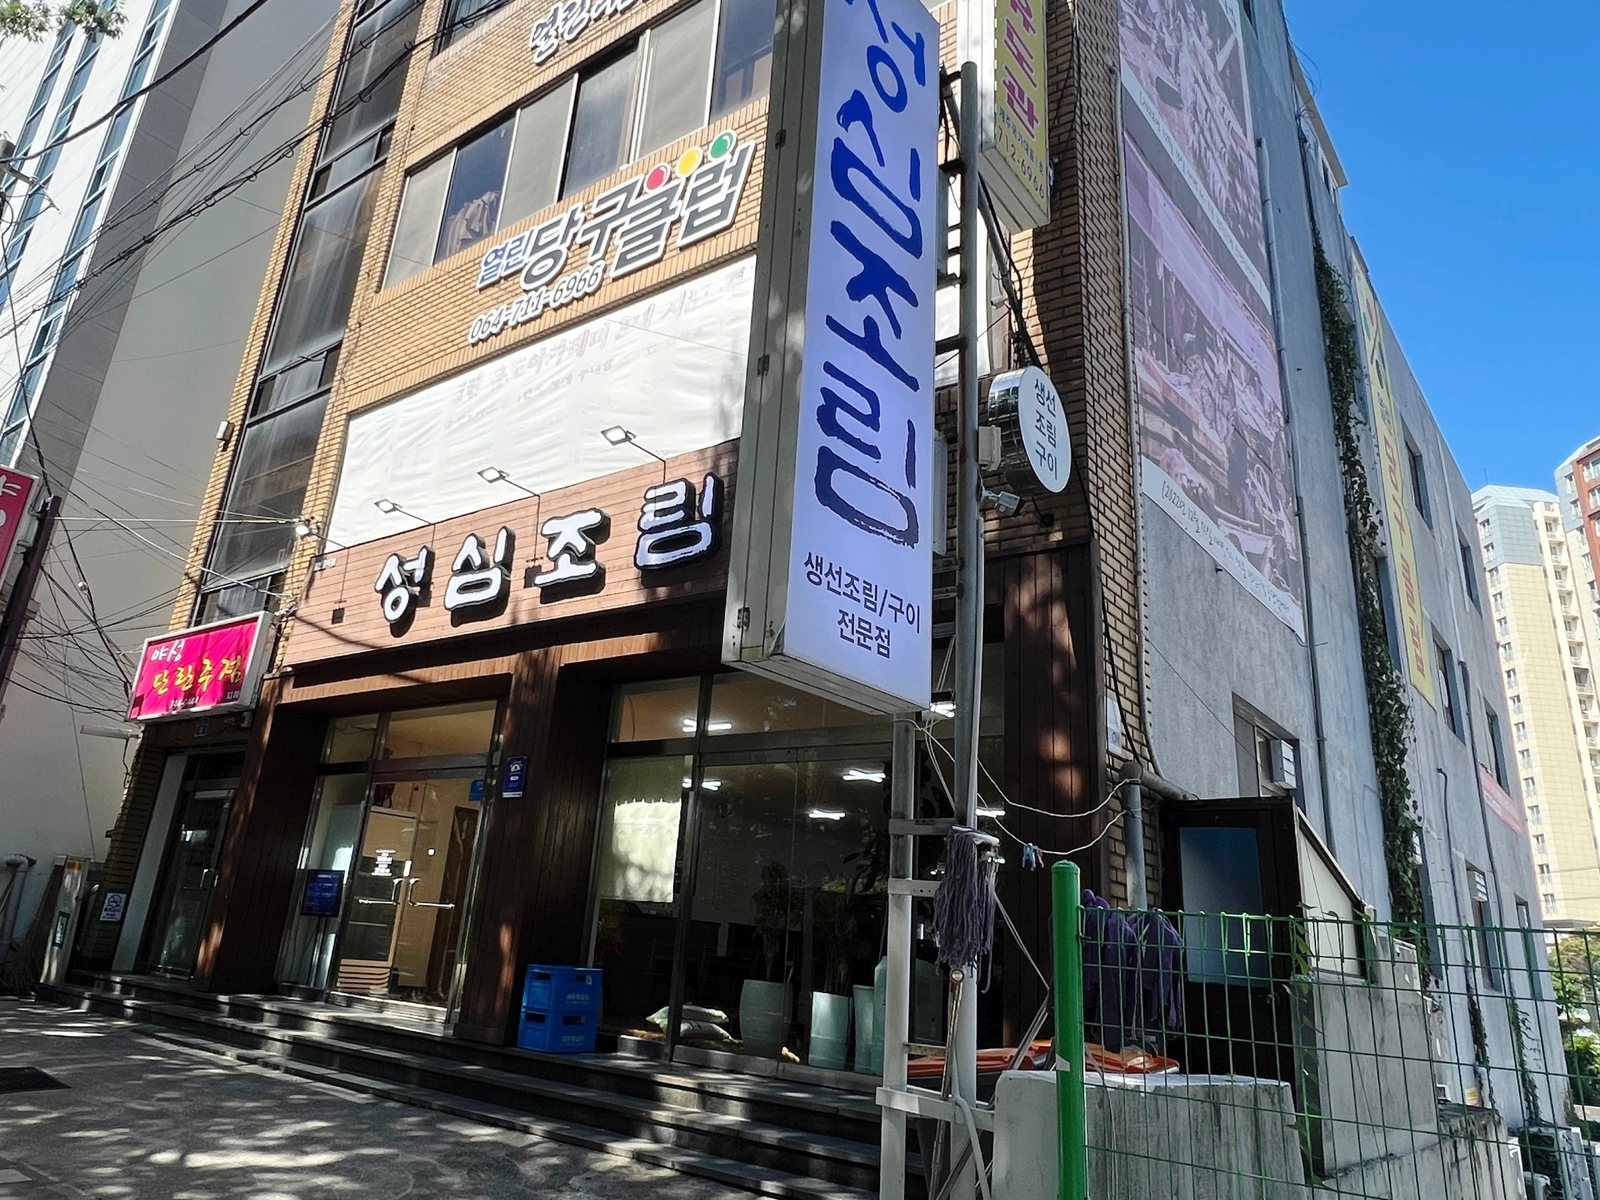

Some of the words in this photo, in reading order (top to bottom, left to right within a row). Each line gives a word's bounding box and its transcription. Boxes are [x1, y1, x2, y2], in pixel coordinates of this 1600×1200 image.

[996, 126, 1045, 200] 712-6966
[468, 261, 605, 344] 064-711-6966
[1035, 378, 1056, 418] 생선
[1035, 410, 1057, 449] 조림
[1035, 440, 1058, 481] 구이
[374, 472, 720, 630] 성심조림
[804, 552, 920, 634] 생선조림/구이
[837, 608, 891, 659] 전문점
[152, 655, 242, 697] 단란주점
